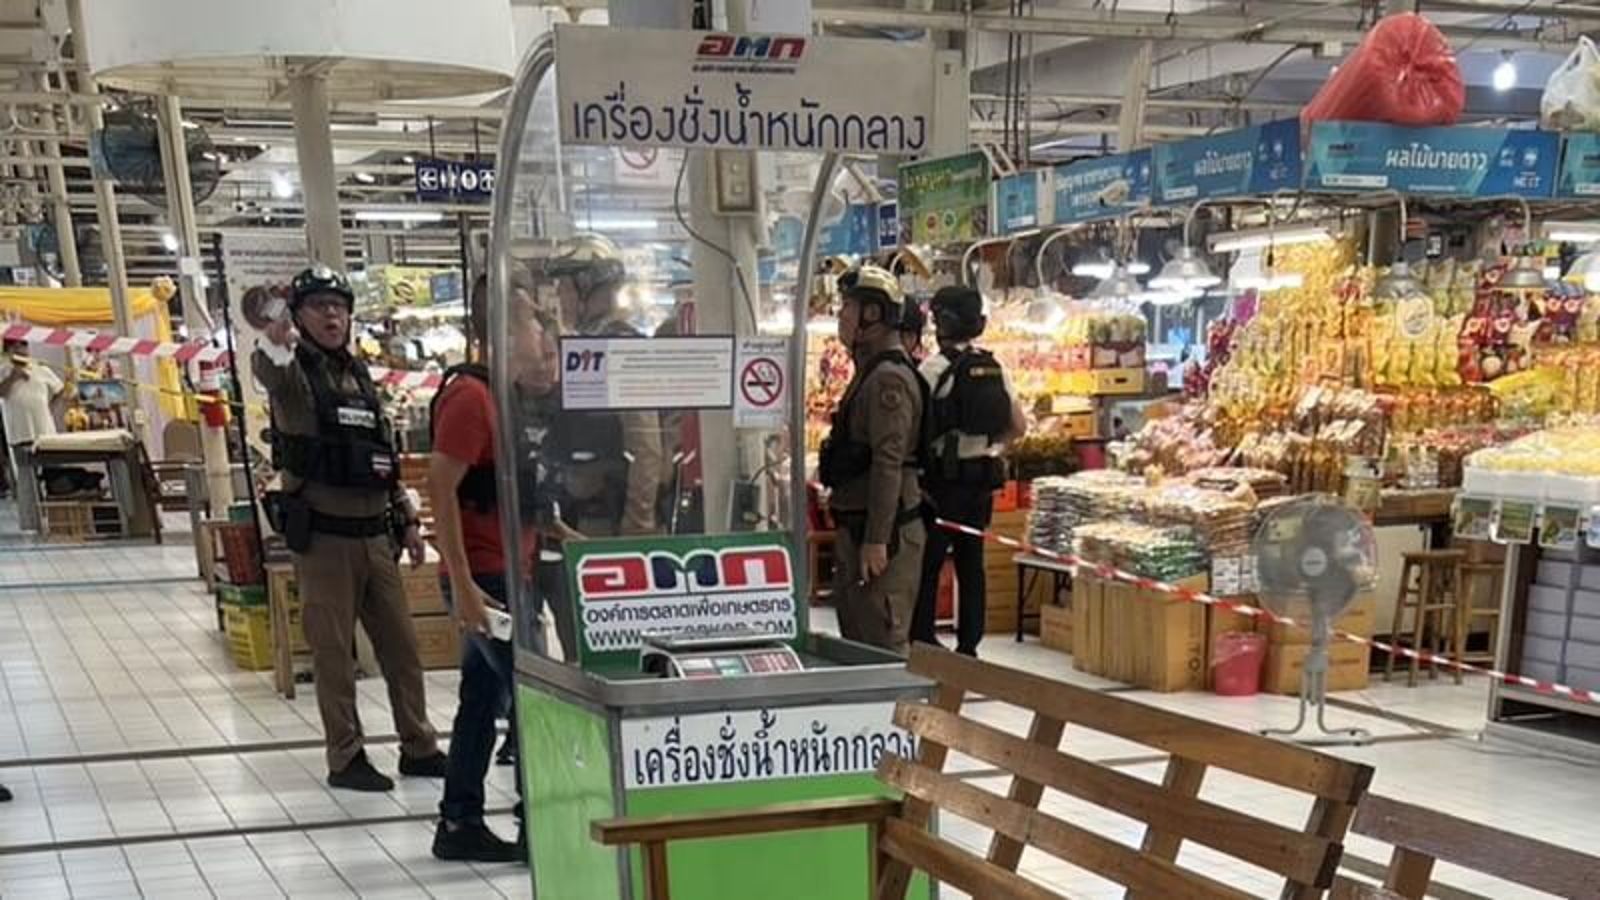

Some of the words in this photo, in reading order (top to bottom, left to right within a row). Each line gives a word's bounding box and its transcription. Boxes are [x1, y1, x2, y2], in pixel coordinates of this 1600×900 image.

[573, 82, 925, 151] เครื่องชั่งน้ำหนักกลาง
[587, 598, 791, 624] องค์การตลาดเพื่อเกษตรกร
